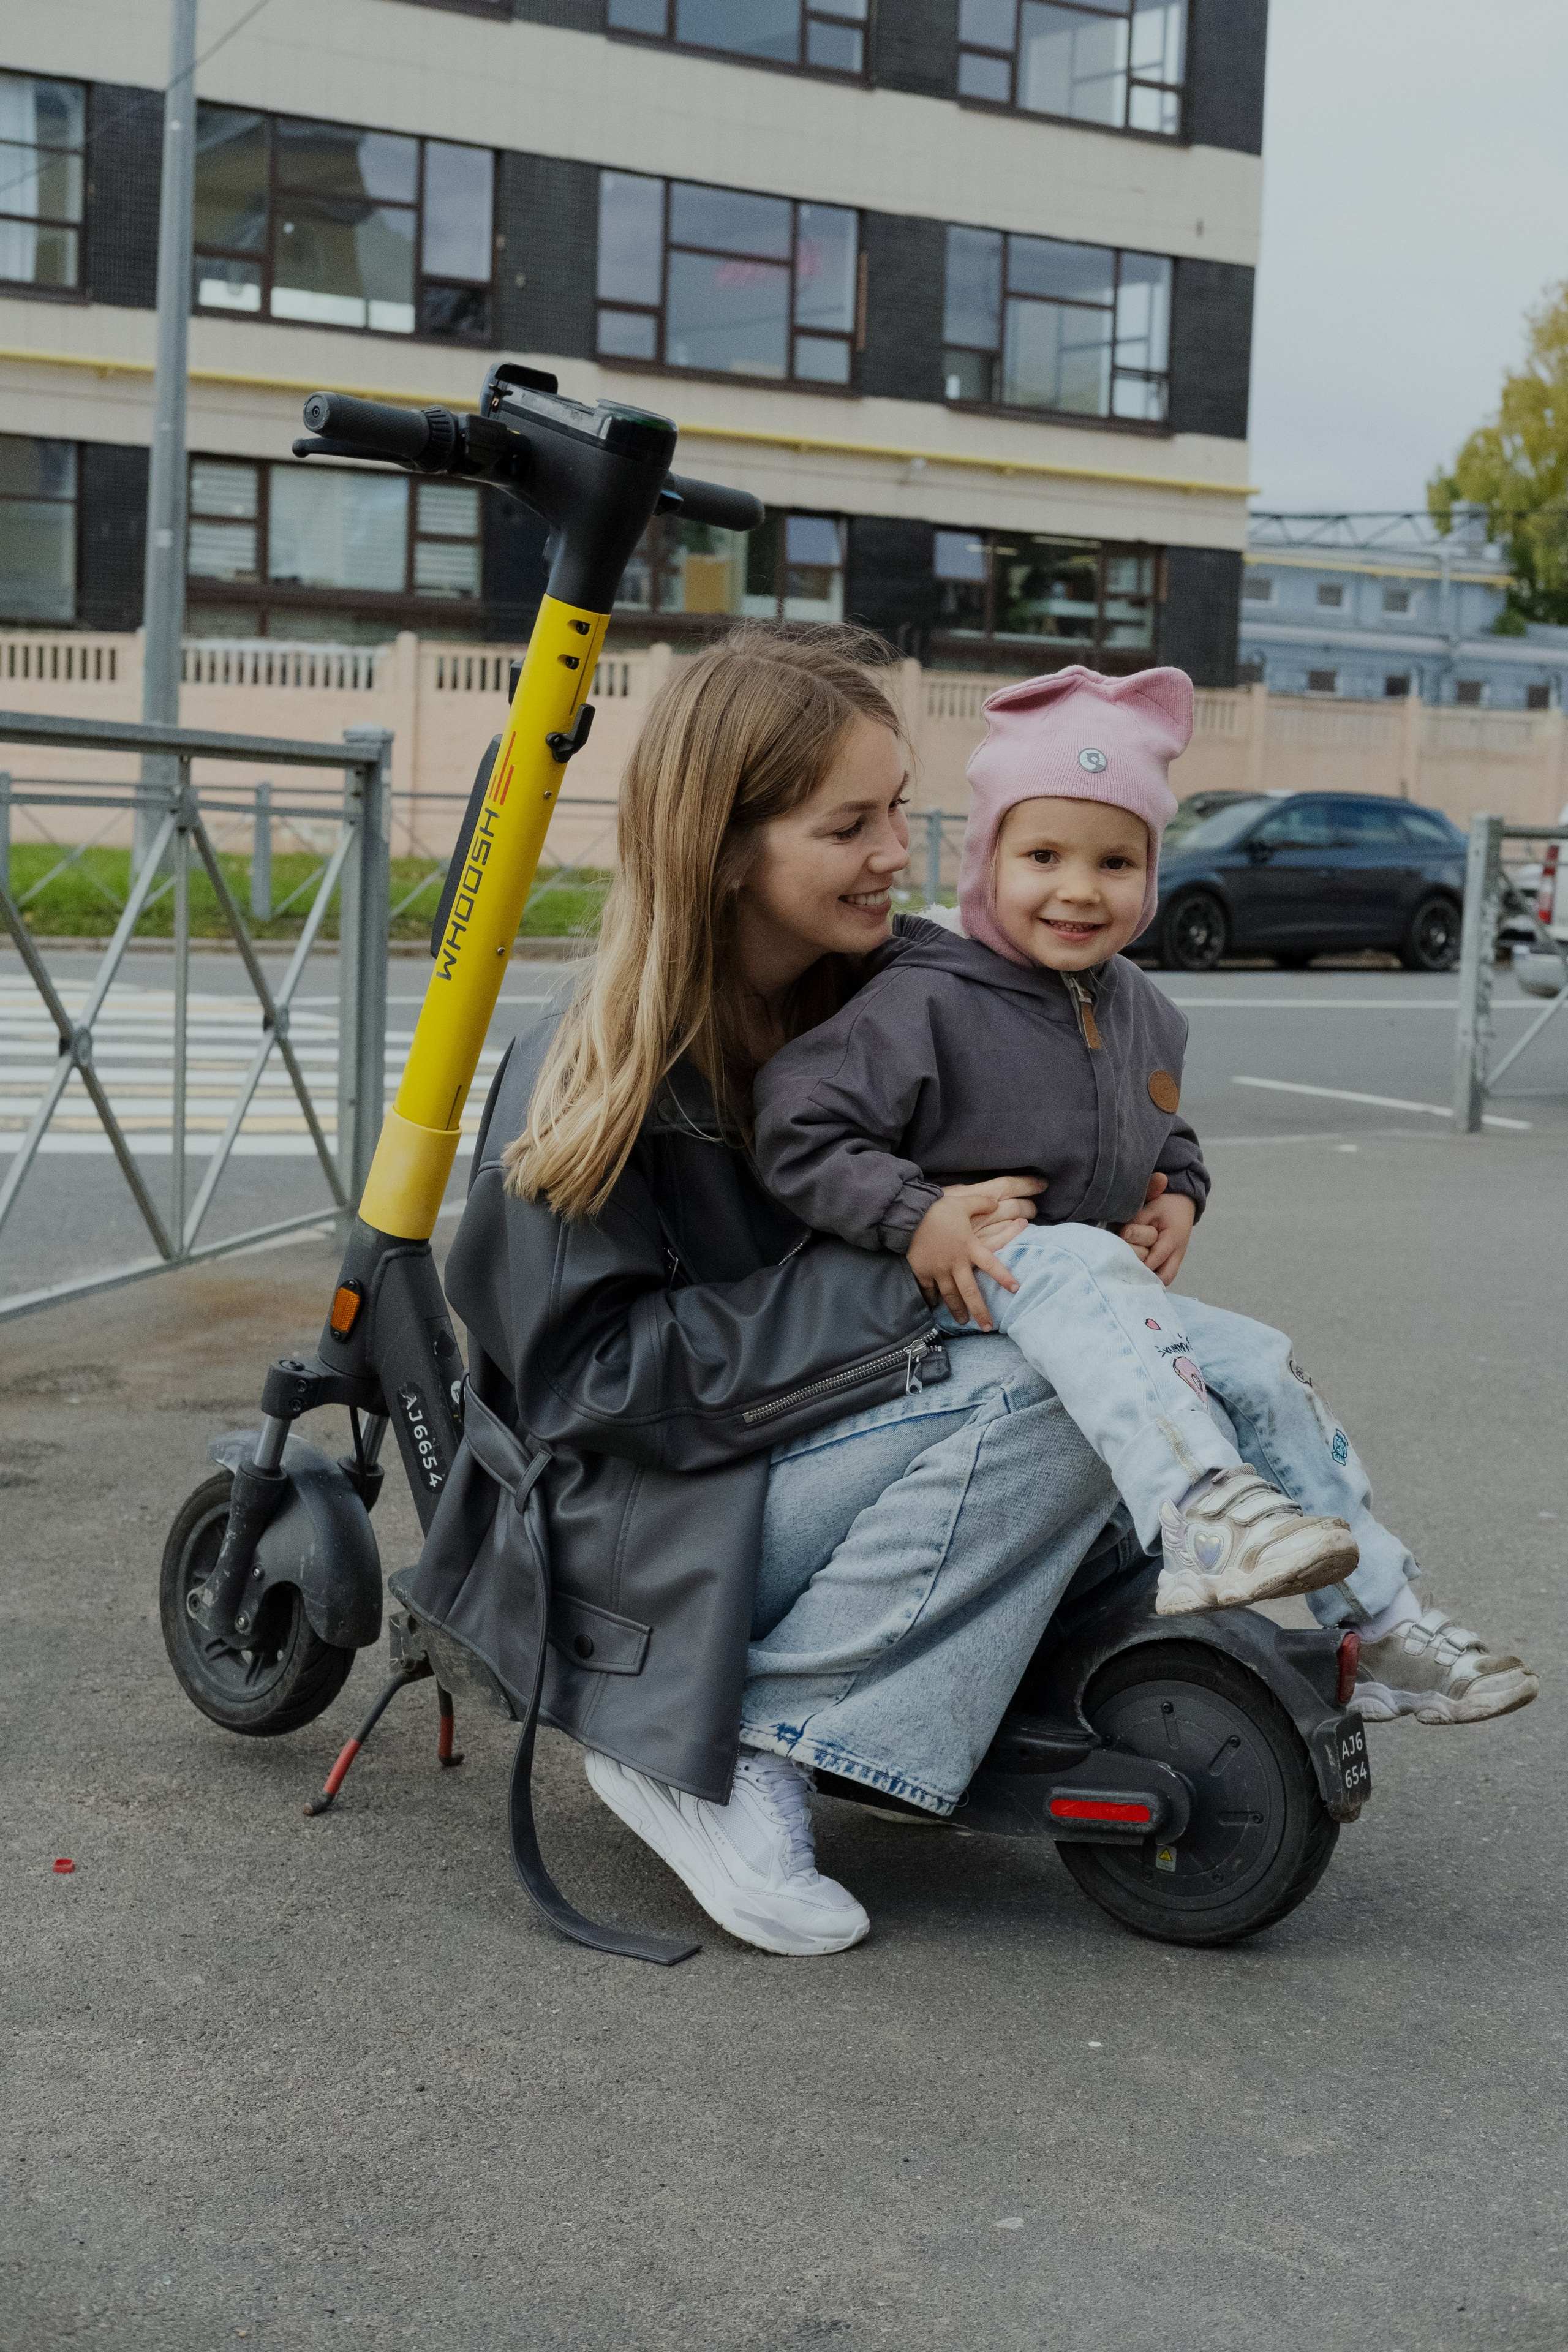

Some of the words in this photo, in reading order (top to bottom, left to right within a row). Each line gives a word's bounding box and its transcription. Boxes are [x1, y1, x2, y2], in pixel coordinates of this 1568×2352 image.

[436, 807, 500, 981] WHOOSH
[400, 1391, 442, 1487] AJ6654
[1342, 1731, 1363, 1760] AJ6
[1345, 1761, 1368, 1789] 654
